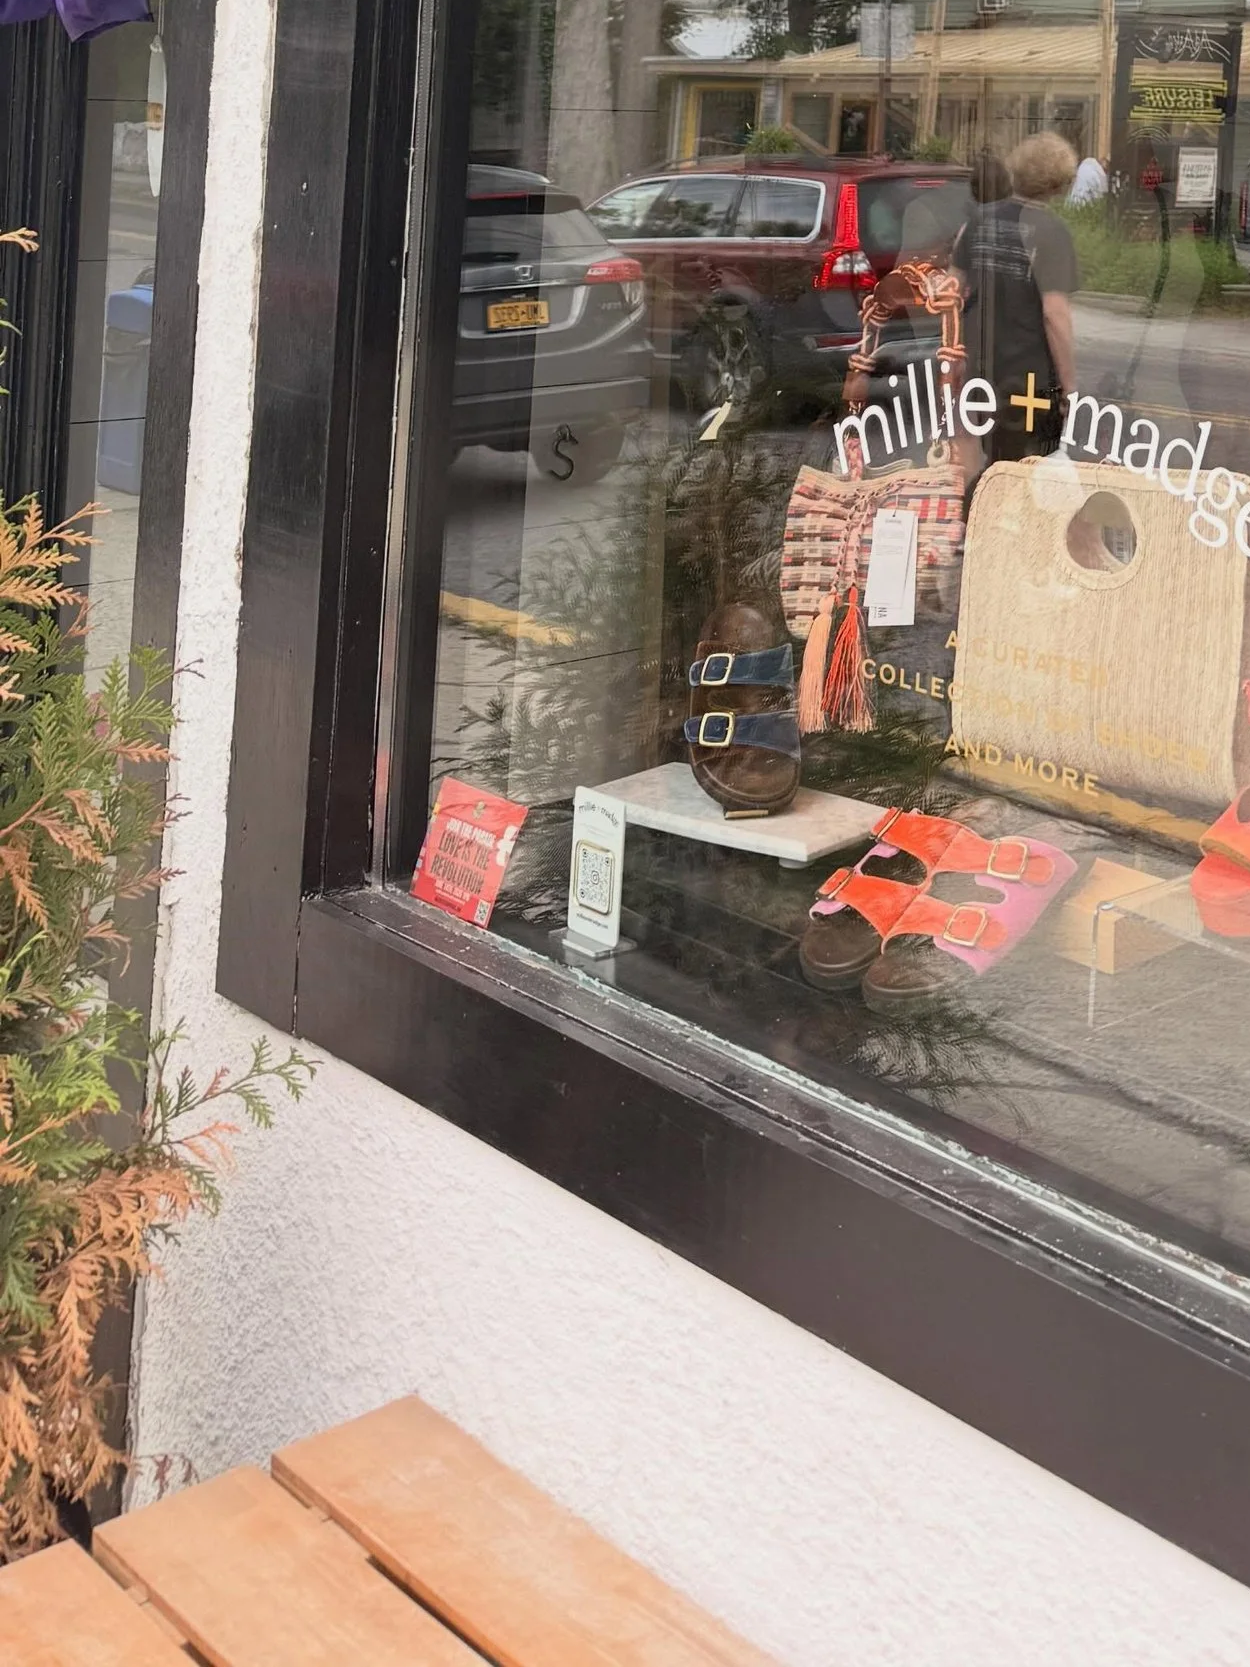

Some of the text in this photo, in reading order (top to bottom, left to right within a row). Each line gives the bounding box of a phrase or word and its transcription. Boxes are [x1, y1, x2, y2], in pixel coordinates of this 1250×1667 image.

[832, 358, 998, 474] millie
[1009, 371, 1051, 432] +
[944, 629, 1109, 690] A CURATED
[862, 657, 1209, 772] COLLECTION OF SHOES
[944, 736, 1101, 798] AND MORE
[430, 853, 485, 895] REVOLUTION
[438, 830, 490, 870] LOVE IS THE
